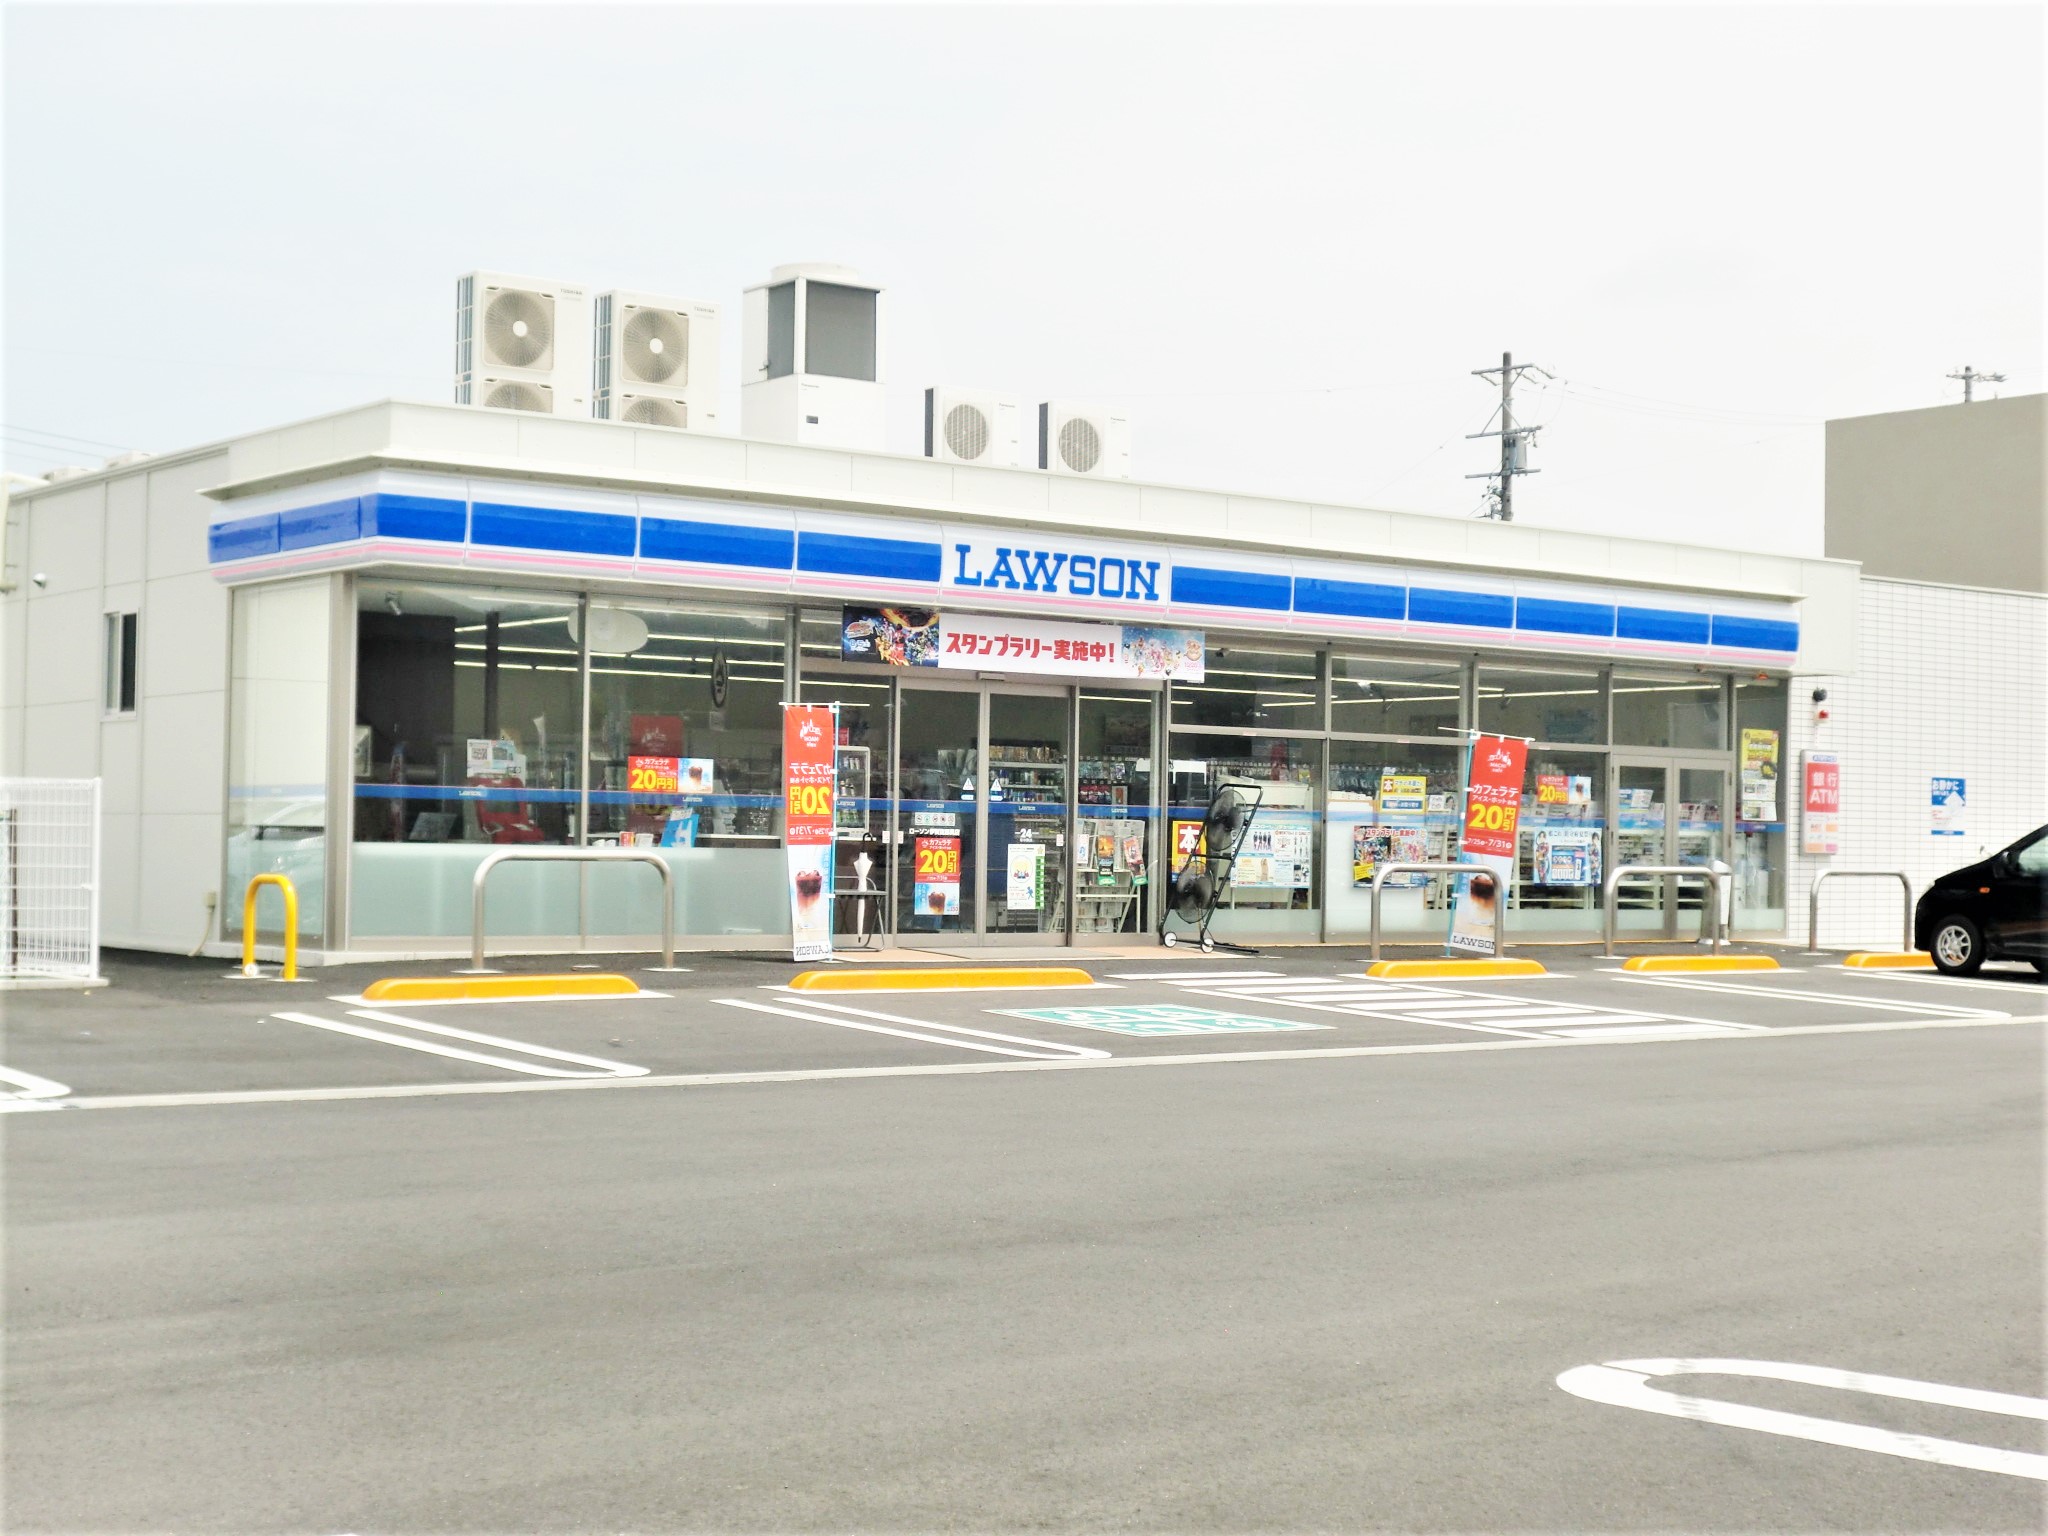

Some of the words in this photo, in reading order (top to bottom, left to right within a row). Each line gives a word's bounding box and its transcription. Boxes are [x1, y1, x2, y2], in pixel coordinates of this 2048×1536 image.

[954, 544, 1160, 600] LAWSON
[946, 632, 1115, 663] スタンプラリー実施中!
[1383, 779, 1394, 792] 本
[1812, 772, 1838, 787] 銀行
[1473, 783, 1519, 798] カフェラテ
[1809, 788, 1838, 804] ATM
[1020, 828, 1033, 839] 24
[1179, 825, 1200, 853] 本
